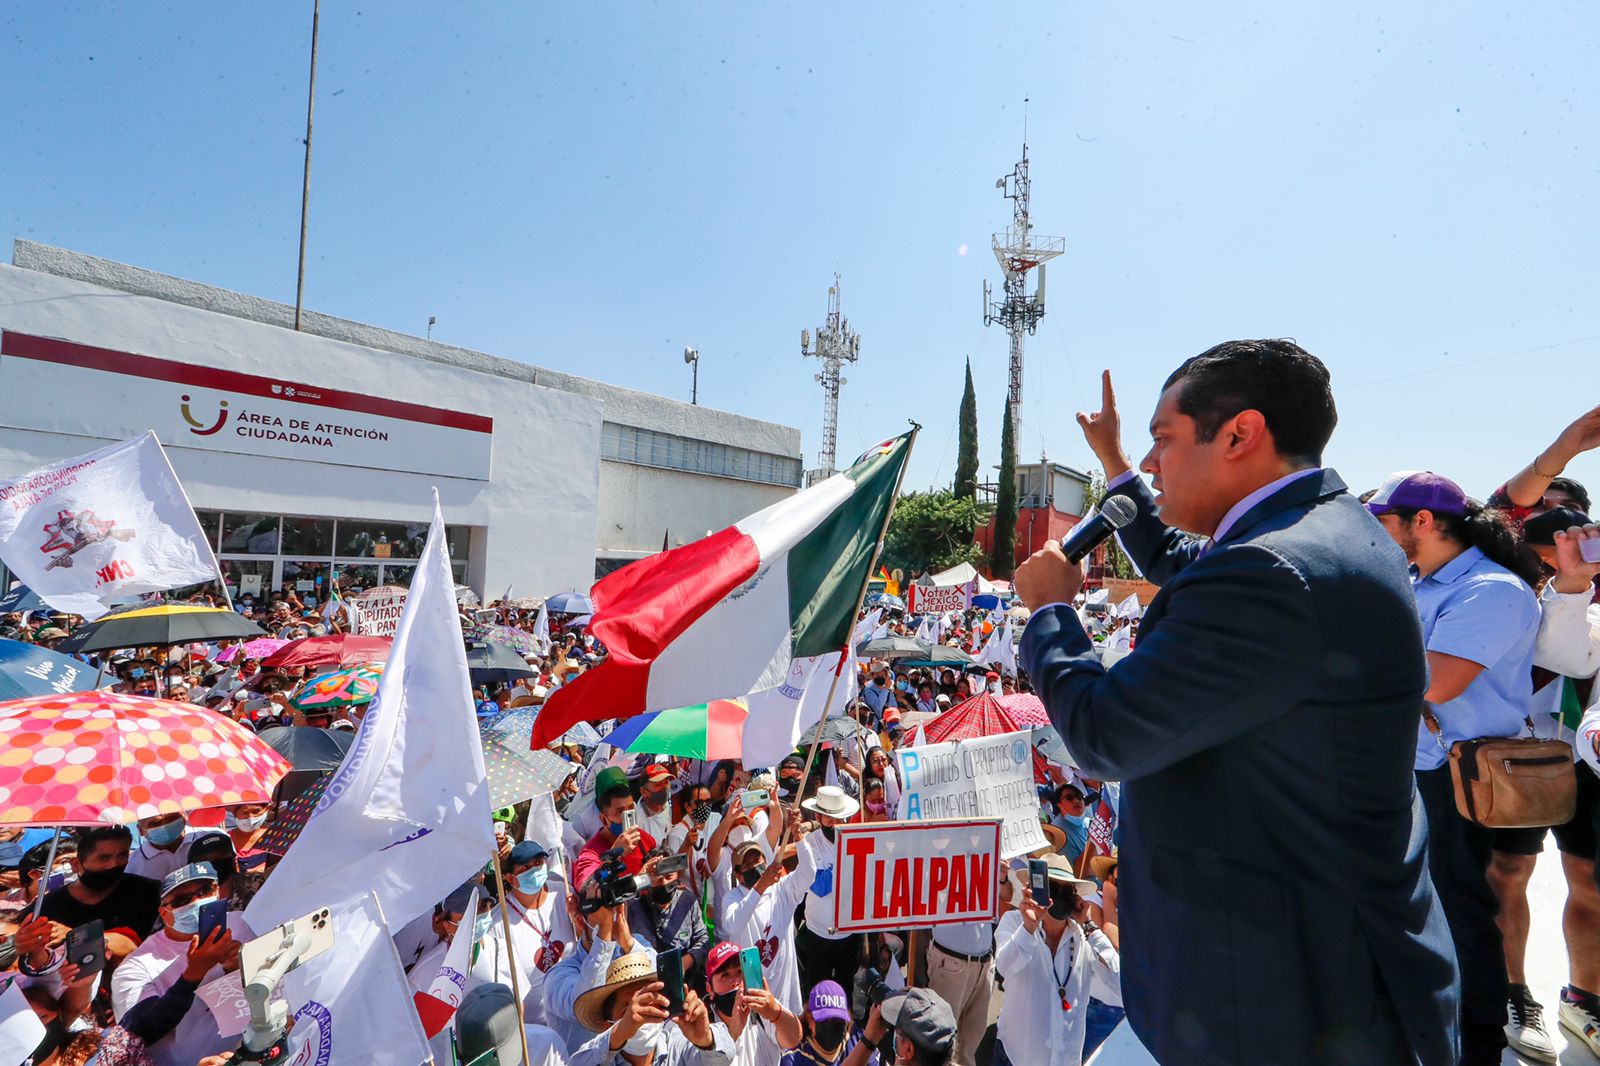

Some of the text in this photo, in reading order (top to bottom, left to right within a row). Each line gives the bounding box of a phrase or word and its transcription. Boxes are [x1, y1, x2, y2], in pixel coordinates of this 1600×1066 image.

[236, 426, 333, 448] CIUDADANA
[237, 410, 389, 441] ÁREA DE ATENCIÓN
[381, 597, 394, 607] LA
[846, 837, 990, 921] TLALPAN
